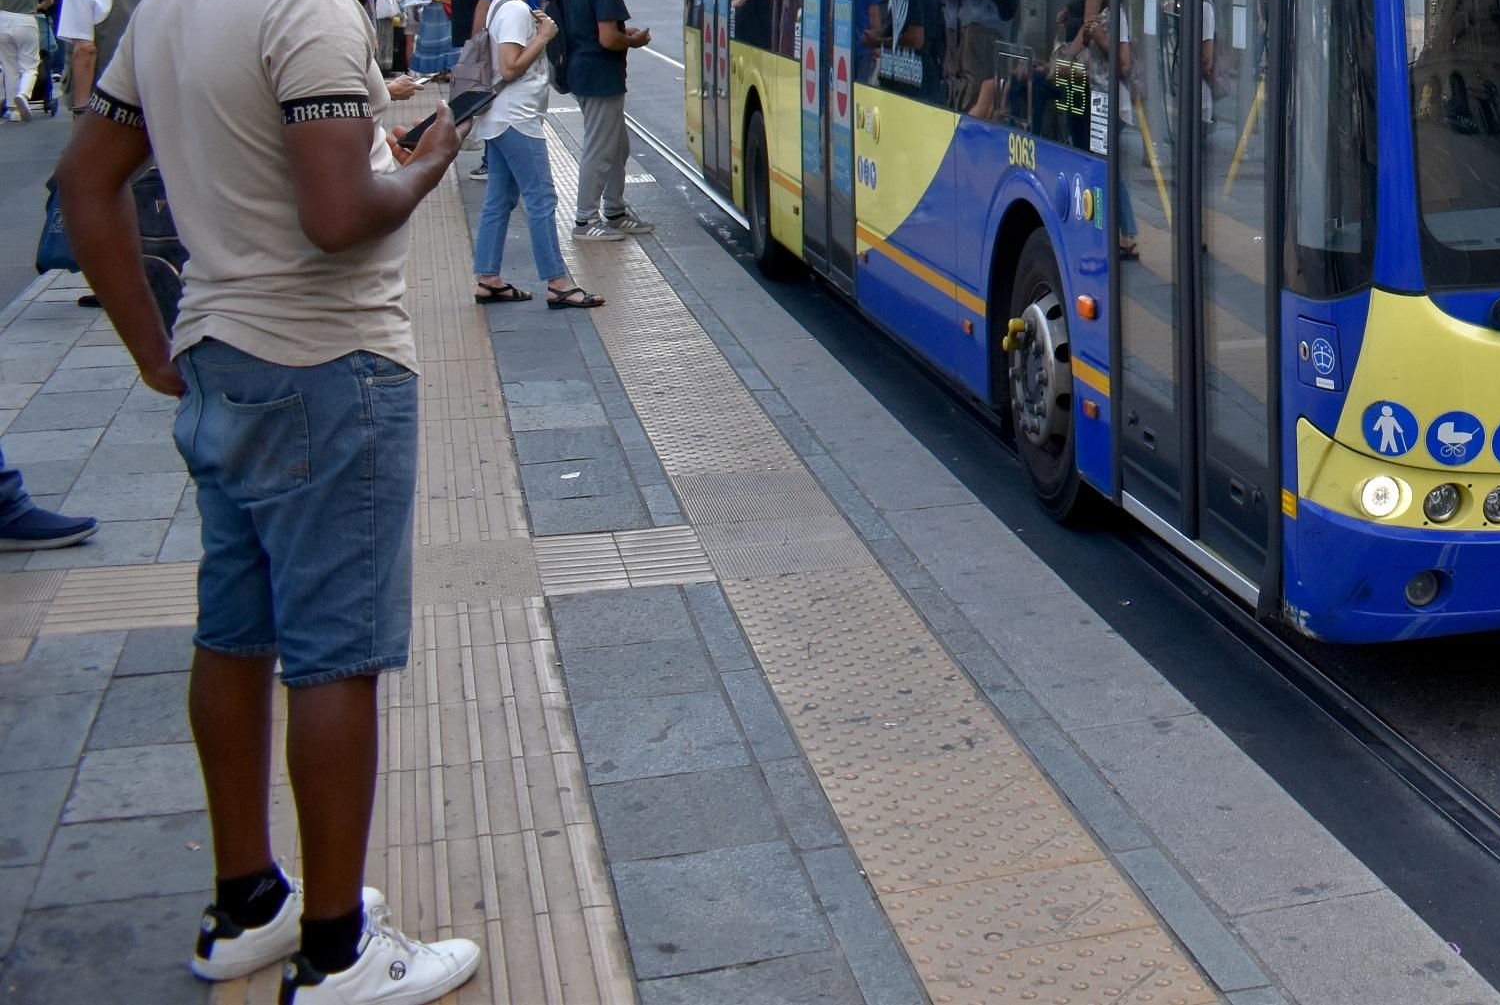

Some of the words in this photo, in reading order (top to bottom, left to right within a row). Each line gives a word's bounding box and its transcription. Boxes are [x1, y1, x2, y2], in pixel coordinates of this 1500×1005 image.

[1055, 58, 1087, 116] 58
[293, 102, 361, 123] DREAM
[1008, 132, 1036, 171] 9063
